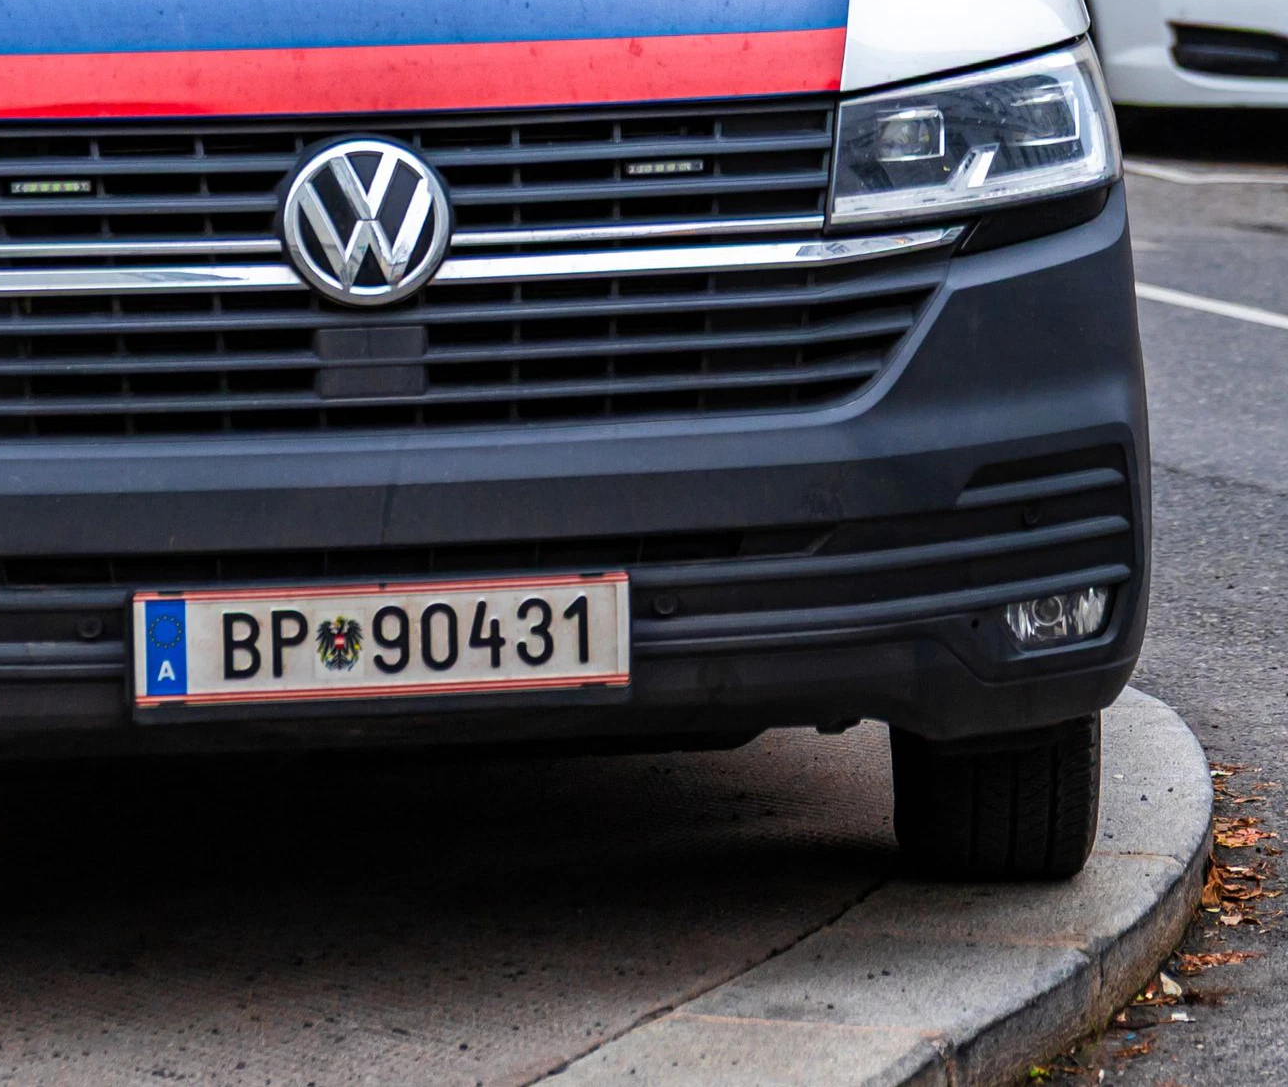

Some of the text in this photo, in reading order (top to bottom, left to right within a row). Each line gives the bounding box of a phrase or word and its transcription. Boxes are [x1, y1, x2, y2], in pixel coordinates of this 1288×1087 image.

[288, 146, 444, 298] VW
[156, 660, 177, 682] A
[222, 595, 589, 681] BP 90431
